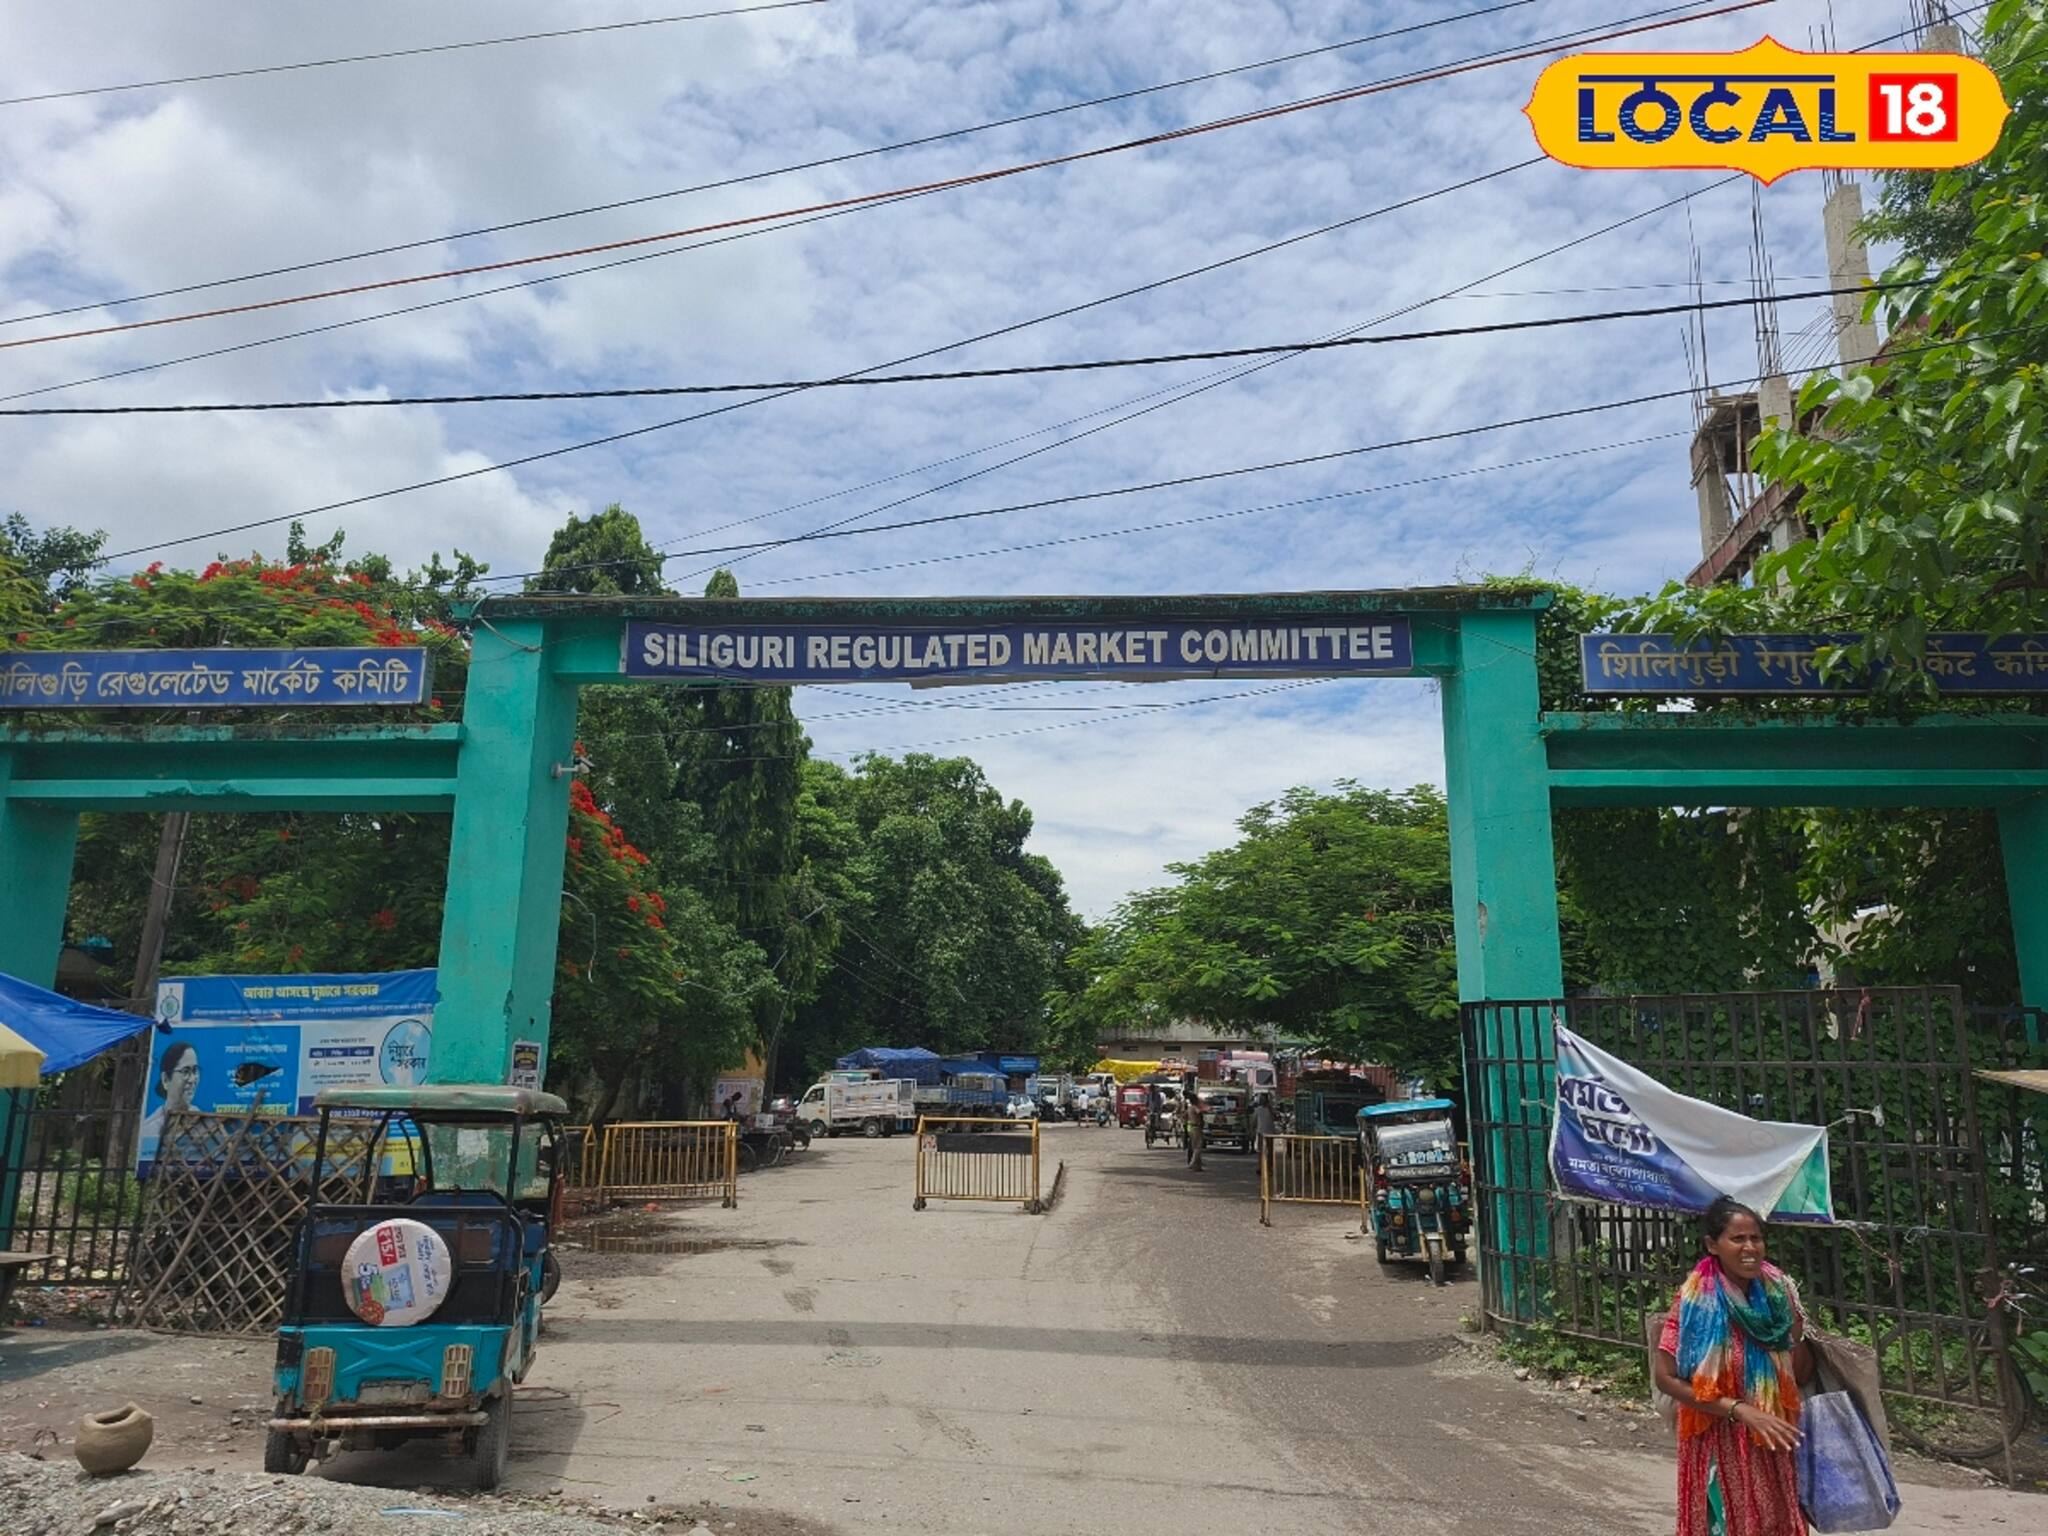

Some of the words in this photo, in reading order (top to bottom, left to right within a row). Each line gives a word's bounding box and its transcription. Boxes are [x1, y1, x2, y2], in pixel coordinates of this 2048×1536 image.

[643, 633, 794, 669] SILIGURI
[806, 634, 1011, 669] REGULATED
[1023, 631, 1168, 664] MARKET
[1180, 626, 1394, 662] COMMITTEE
[0, 661, 93, 702] লিগুড়ি
[98, 661, 234, 695] রেগুলেটেড
[241, 657, 324, 695] মার্কেট
[332, 658, 413, 694] কমিটি
